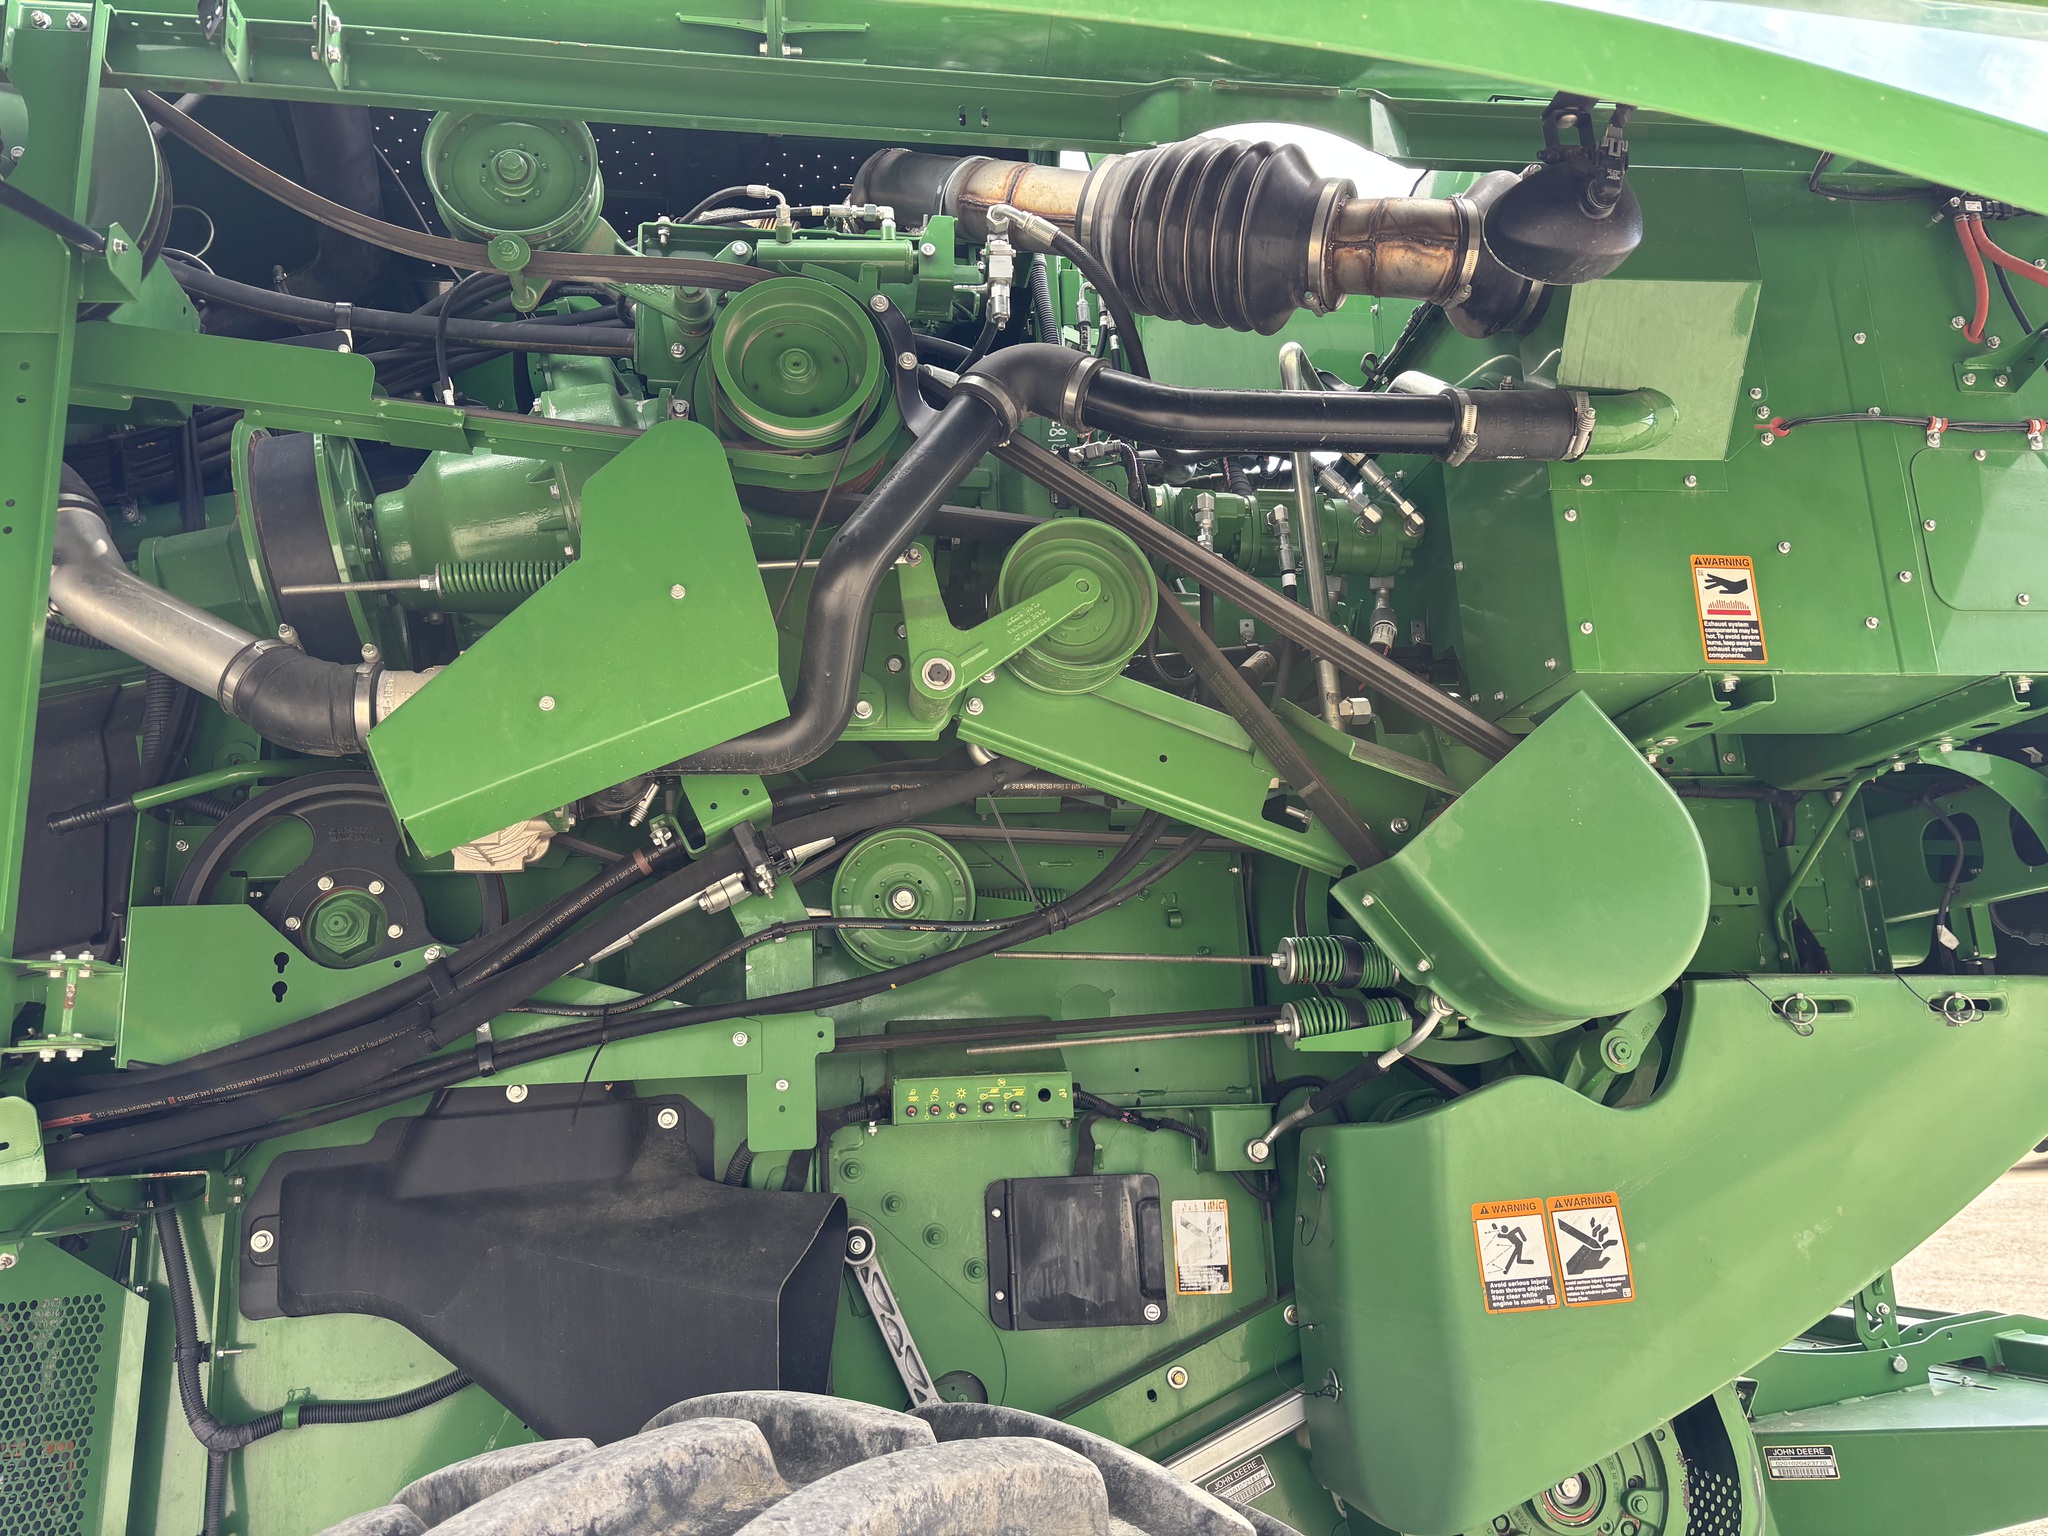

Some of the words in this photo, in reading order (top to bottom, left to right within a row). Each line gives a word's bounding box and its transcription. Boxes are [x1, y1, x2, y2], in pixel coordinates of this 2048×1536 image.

[1702, 558, 1750, 567] WARNING
[1036, 783, 1053, 791] (3250
[1053, 783, 1065, 791] PSI)
[501, 952, 514, 963] 22.5
[513, 945, 526, 956] MPa
[524, 932, 540, 948] (3250
[539, 925, 552, 937] PSI)
[555, 911, 569, 925] (25.4
[568, 902, 582, 914] mm)
[580, 896, 591, 906] ISO
[588, 885, 605, 899] 11237
[604, 878, 616, 888] R17
[618, 869, 629, 880] SAE
[255, 1072, 279, 1082] Exceeds
[177, 1092, 198, 1102] 100R15
[199, 1089, 211, 1098] SAE
[1564, 1194, 1613, 1207] WARNING
[1491, 1202, 1537, 1214] WARNING
[1530, 1278, 1548, 1286] injury
[1527, 1284, 1551, 1292] objects.
[1491, 1294, 1505, 1302] Stay
[1520, 1297, 1546, 1305] running.
[1772, 1448, 1796, 1456] JOHN
[1796, 1447, 1825, 1455] DEERE
[1214, 1474, 1234, 1490] JOHN
[1233, 1460, 1258, 1479] DEERE
